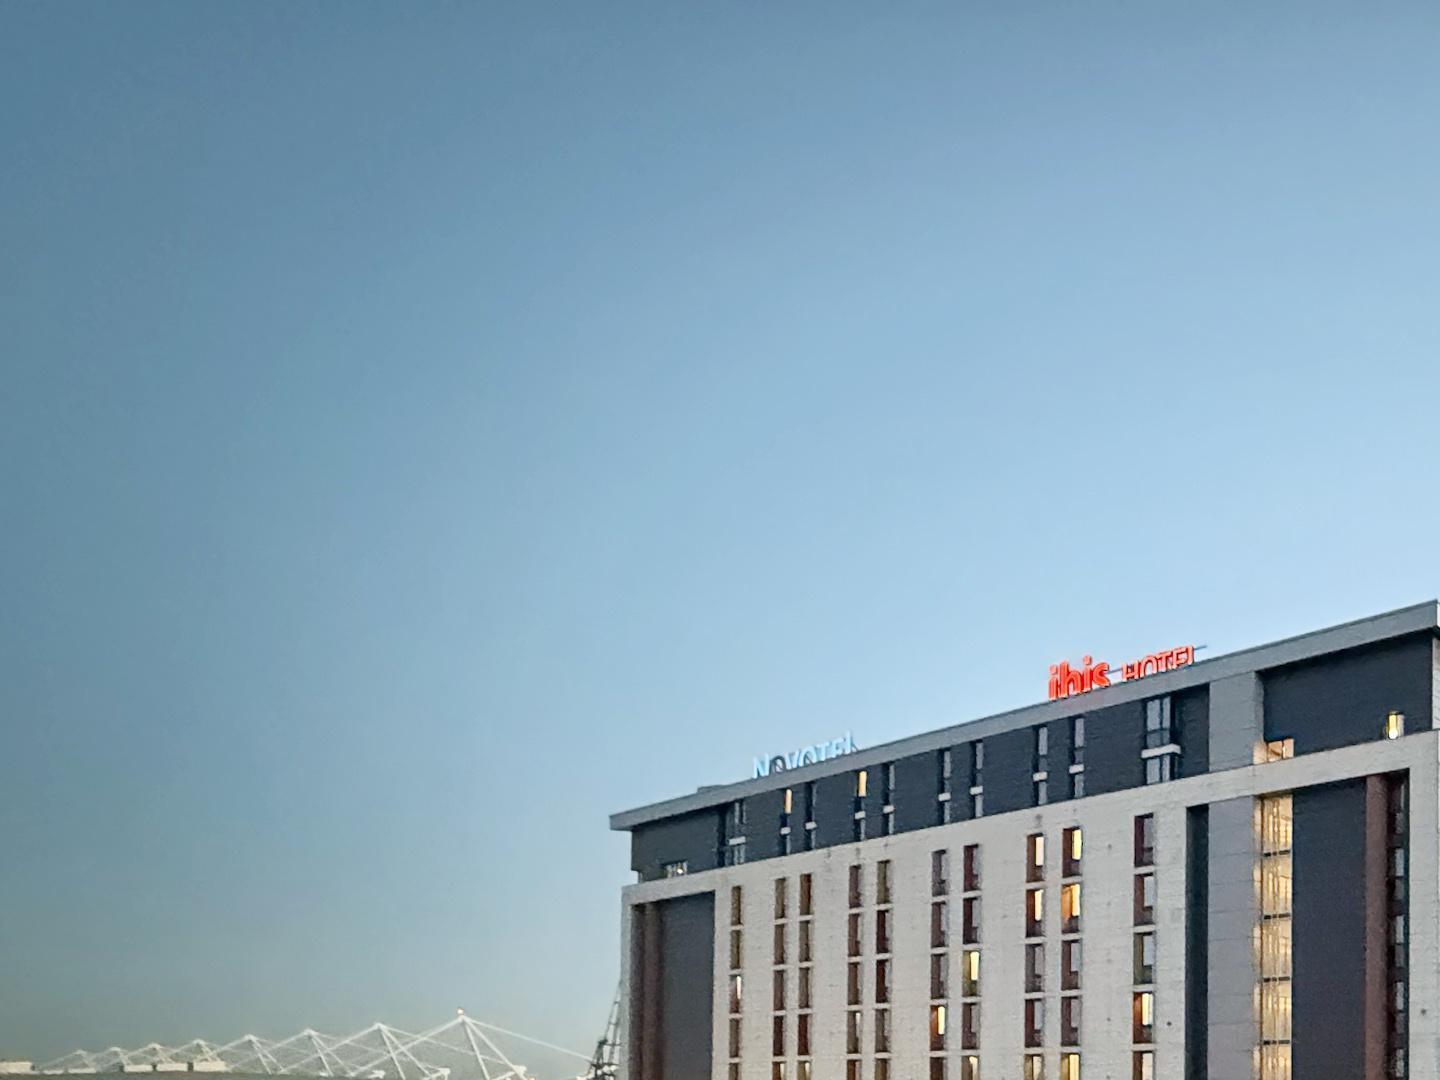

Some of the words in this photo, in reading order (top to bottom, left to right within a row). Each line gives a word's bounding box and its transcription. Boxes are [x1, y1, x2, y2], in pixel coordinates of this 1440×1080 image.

[1047, 655, 1111, 701] ibis
[1120, 645, 1195, 682] HOTEL
[752, 730, 853, 779] NOVOTEL
